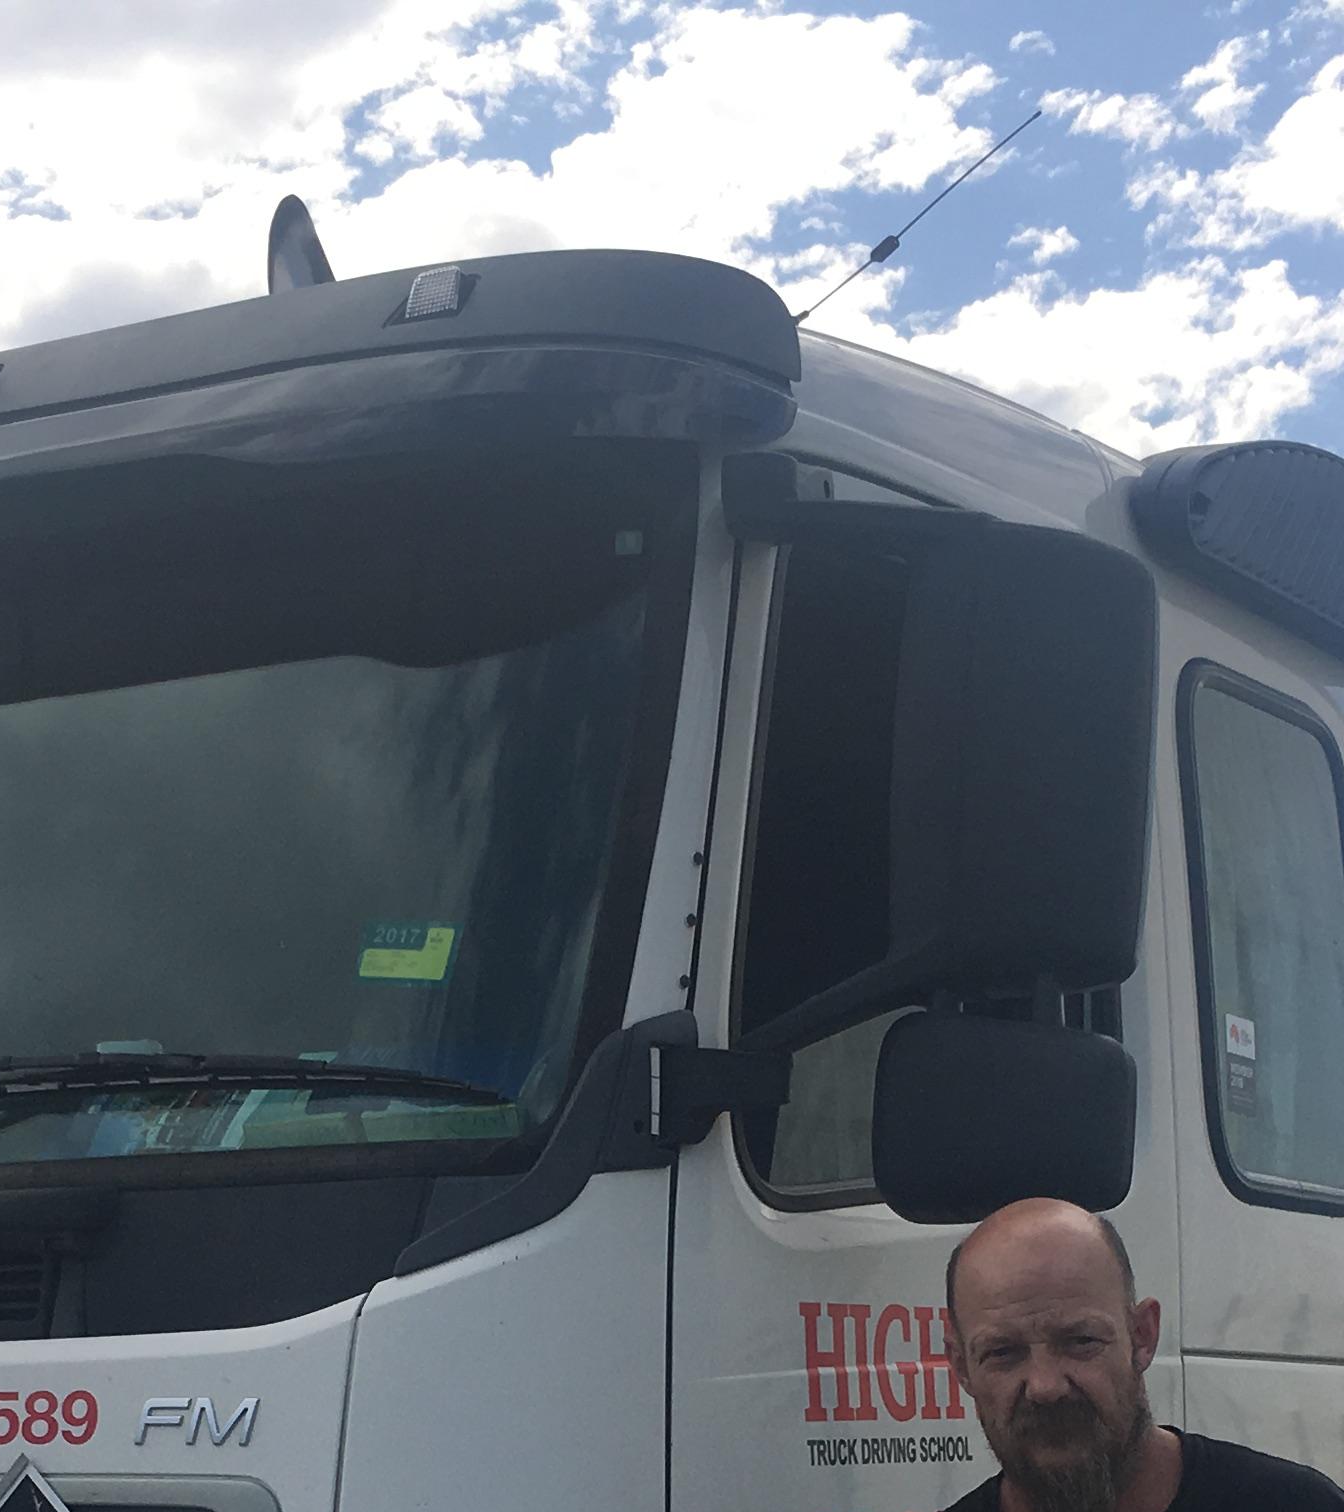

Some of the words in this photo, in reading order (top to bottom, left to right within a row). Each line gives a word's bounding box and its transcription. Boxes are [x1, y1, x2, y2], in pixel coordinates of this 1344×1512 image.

[373, 927, 421, 943] 2017
[134, 1396, 260, 1447] FM
[807, 1438, 858, 1466] TRUCK
[861, 1437, 916, 1464] DRIVING
[920, 1436, 973, 1462] SCHOOL
